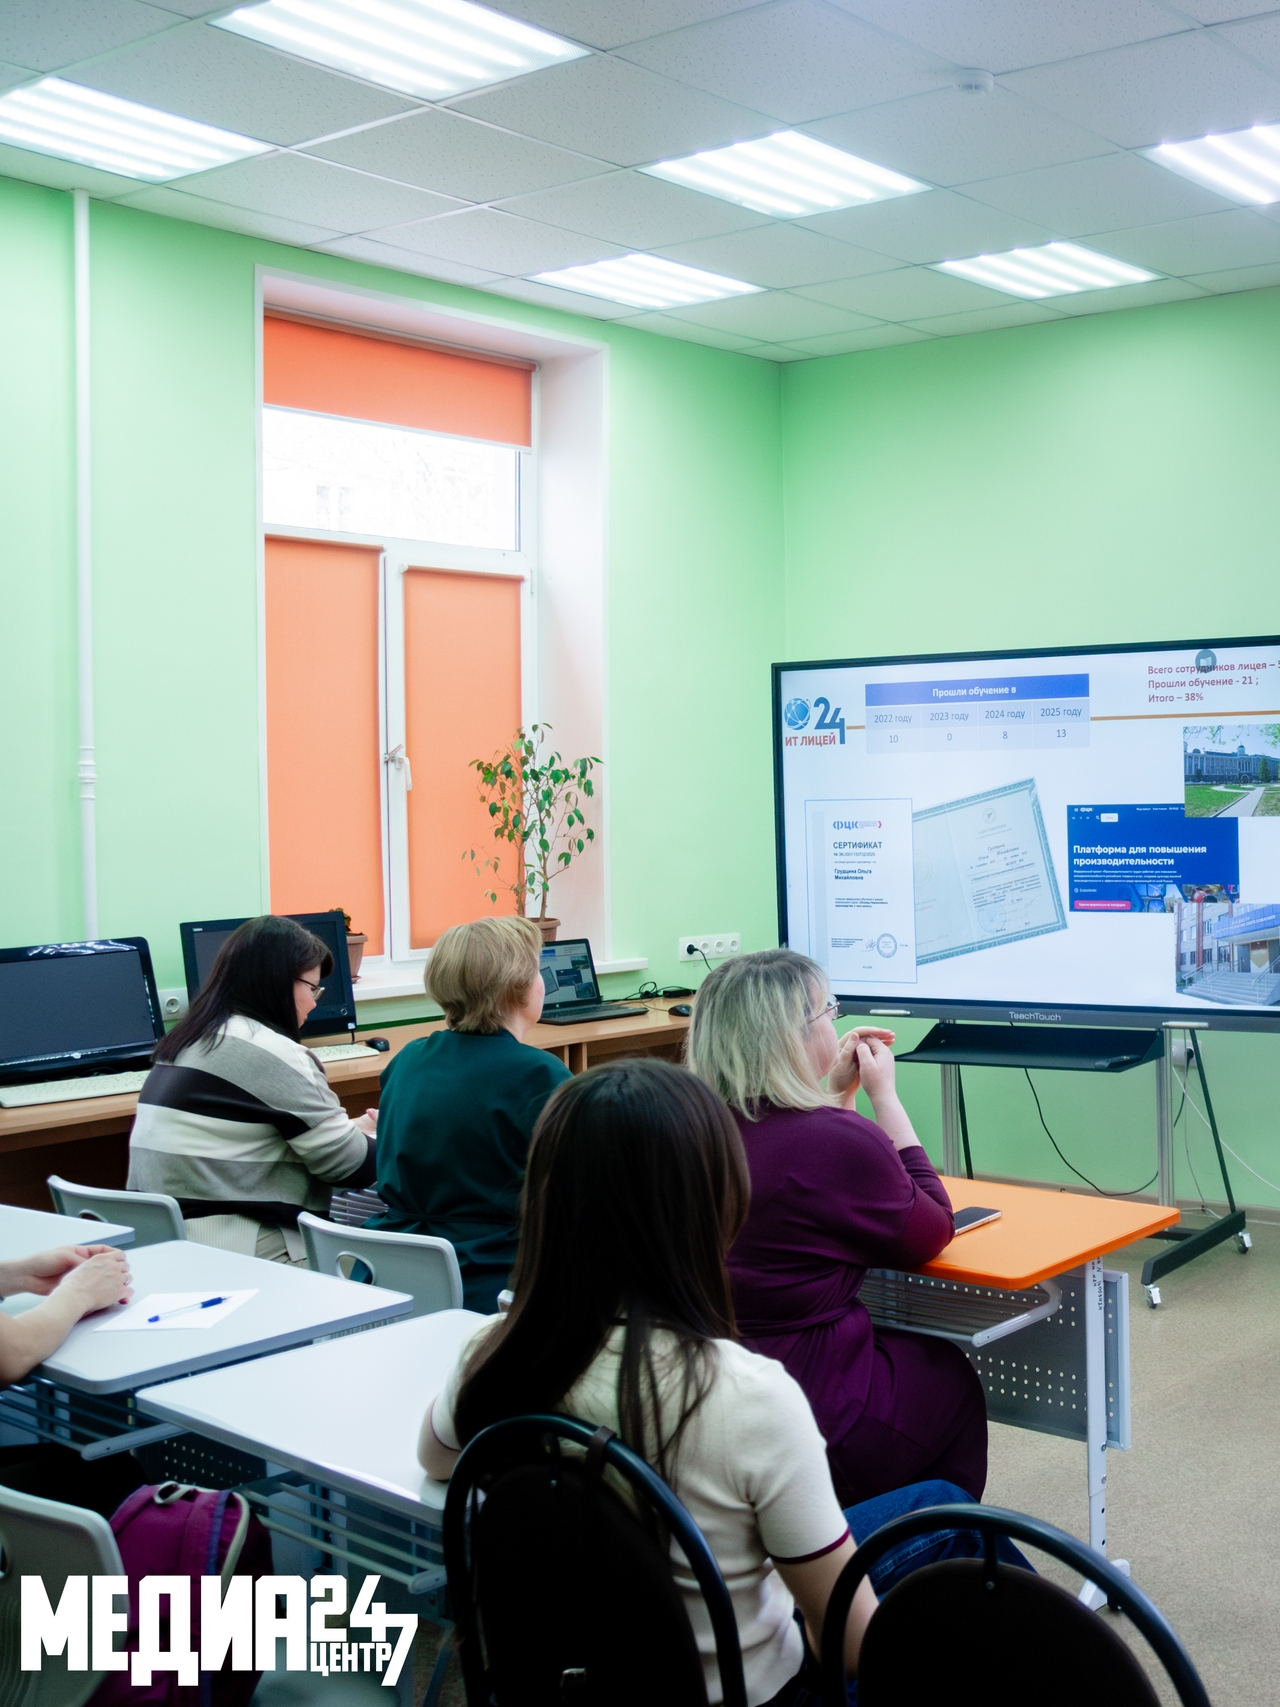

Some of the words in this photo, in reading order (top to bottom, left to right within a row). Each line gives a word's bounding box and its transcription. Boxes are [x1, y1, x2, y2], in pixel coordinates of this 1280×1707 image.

[1148, 665, 1173, 674] Всего
[1175, 664, 1235, 675] сотрудников
[1237, 661, 1267, 671] лицея
[1148, 679, 1186, 690] Прошли
[1188, 677, 1233, 688] обучение
[1241, 676, 1253, 685] 21
[932, 688, 967, 699] Прошли
[968, 686, 1009, 697] обучение
[1148, 693, 1174, 703] Итого
[1184, 692, 1204, 702] 38%
[929, 712, 949, 721] 2023
[951, 711, 969, 722] году
[984, 710, 1005, 719] 2024
[1006, 710, 1026, 720] году
[1040, 708, 1061, 717] 2025
[1062, 707, 1083, 718] году
[813, 696, 846, 745] 24
[874, 715, 893, 724] 2022
[895, 714, 913, 724] году
[946, 733, 953, 742] 0
[1002, 731, 1008, 740] 8
[1056, 729, 1067, 738] 13
[785, 736, 798, 747] ИТ
[800, 732, 836, 747] ЛИЦЕЙ
[889, 735, 899, 744] 10
[833, 841, 883, 849] СЕРТИФИКАТ
[1073, 845, 1127, 855] Платформа
[1128, 846, 1147, 855] для
[1149, 846, 1207, 854] повышения
[1073, 858, 1175, 867] производительности
[1009, 1011, 1062, 1021] TeachTouch
